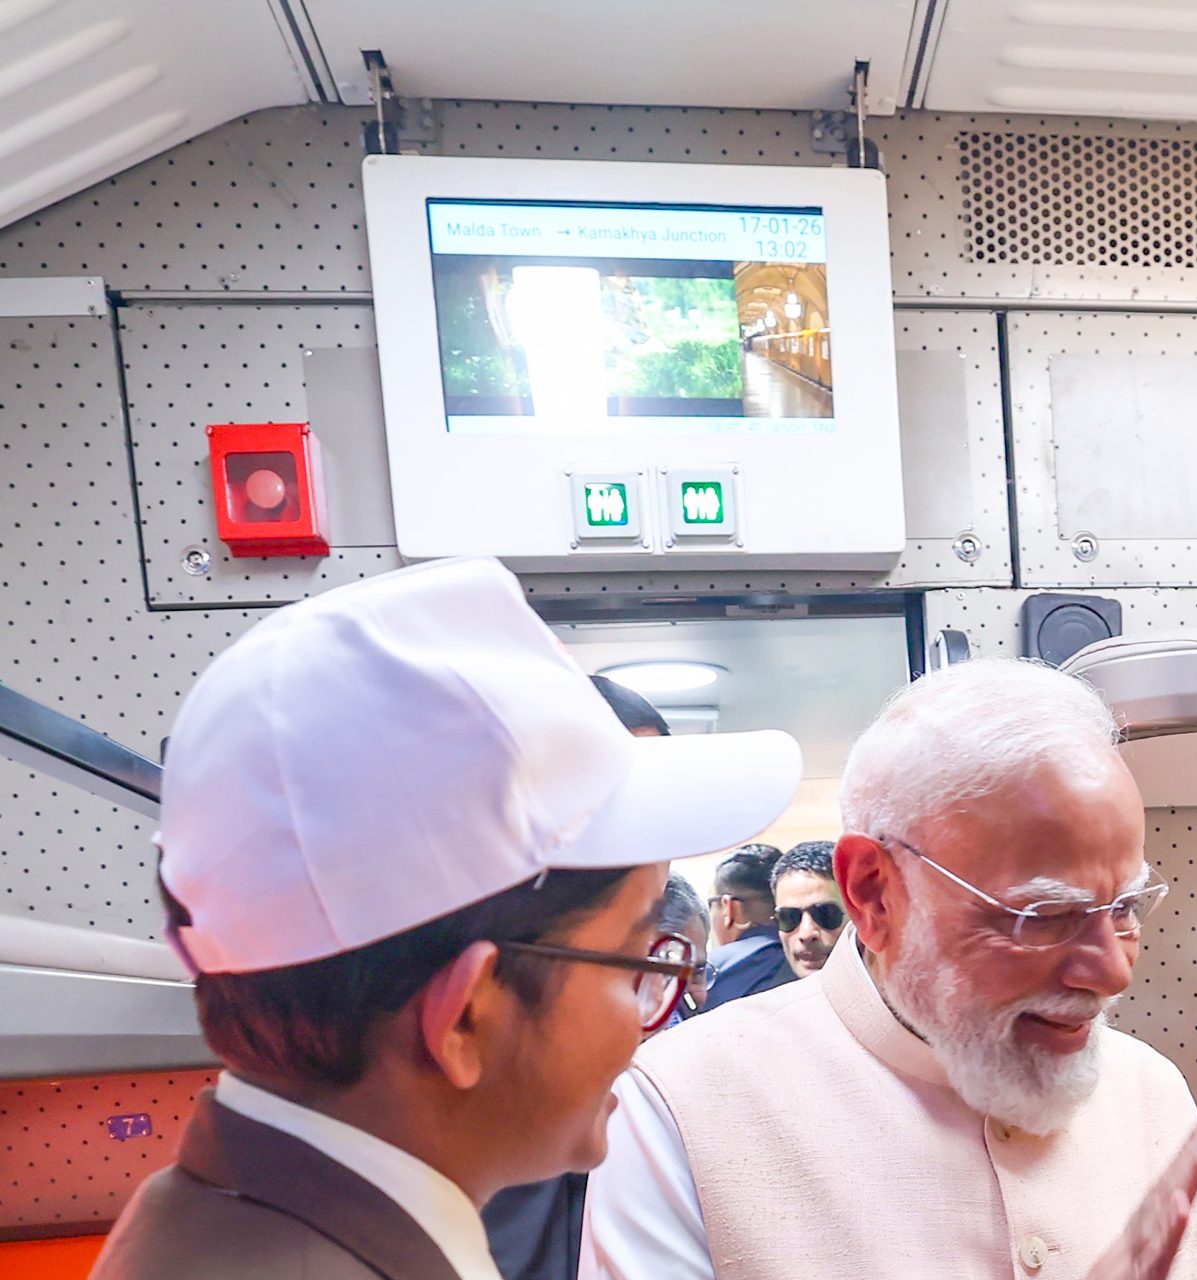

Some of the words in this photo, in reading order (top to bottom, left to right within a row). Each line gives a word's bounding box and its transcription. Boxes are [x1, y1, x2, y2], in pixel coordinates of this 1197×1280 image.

[446, 222, 496, 238] Malda
[500, 223, 543, 238] Town
[578, 225, 657, 244] Kamakhya
[662, 228, 727, 243] Junction
[738, 216, 823, 236] 17-01-26
[756, 240, 808, 258] 13:02
[122, 1118, 134, 1135] 7
